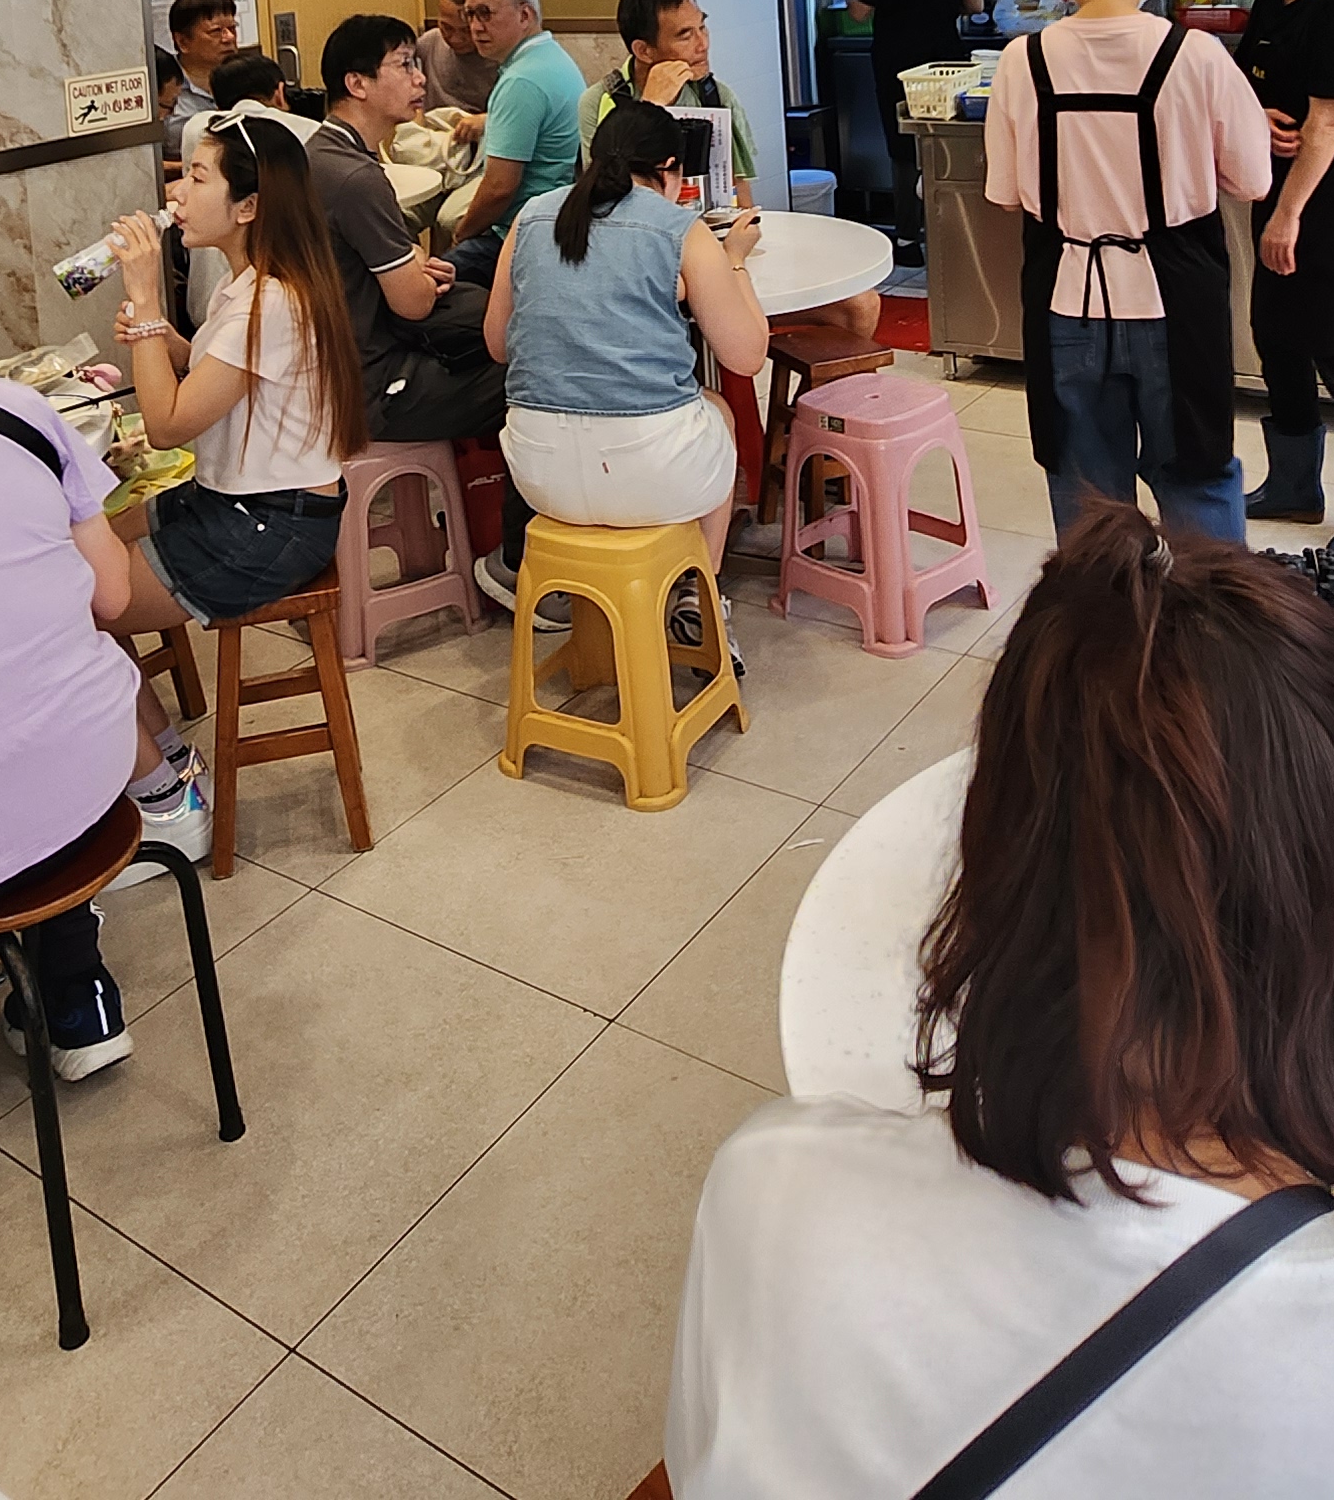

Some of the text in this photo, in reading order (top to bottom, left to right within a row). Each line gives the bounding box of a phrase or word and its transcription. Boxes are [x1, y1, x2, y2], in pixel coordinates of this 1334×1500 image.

[72, 77, 143, 99] CAUTION WET FLOOR
